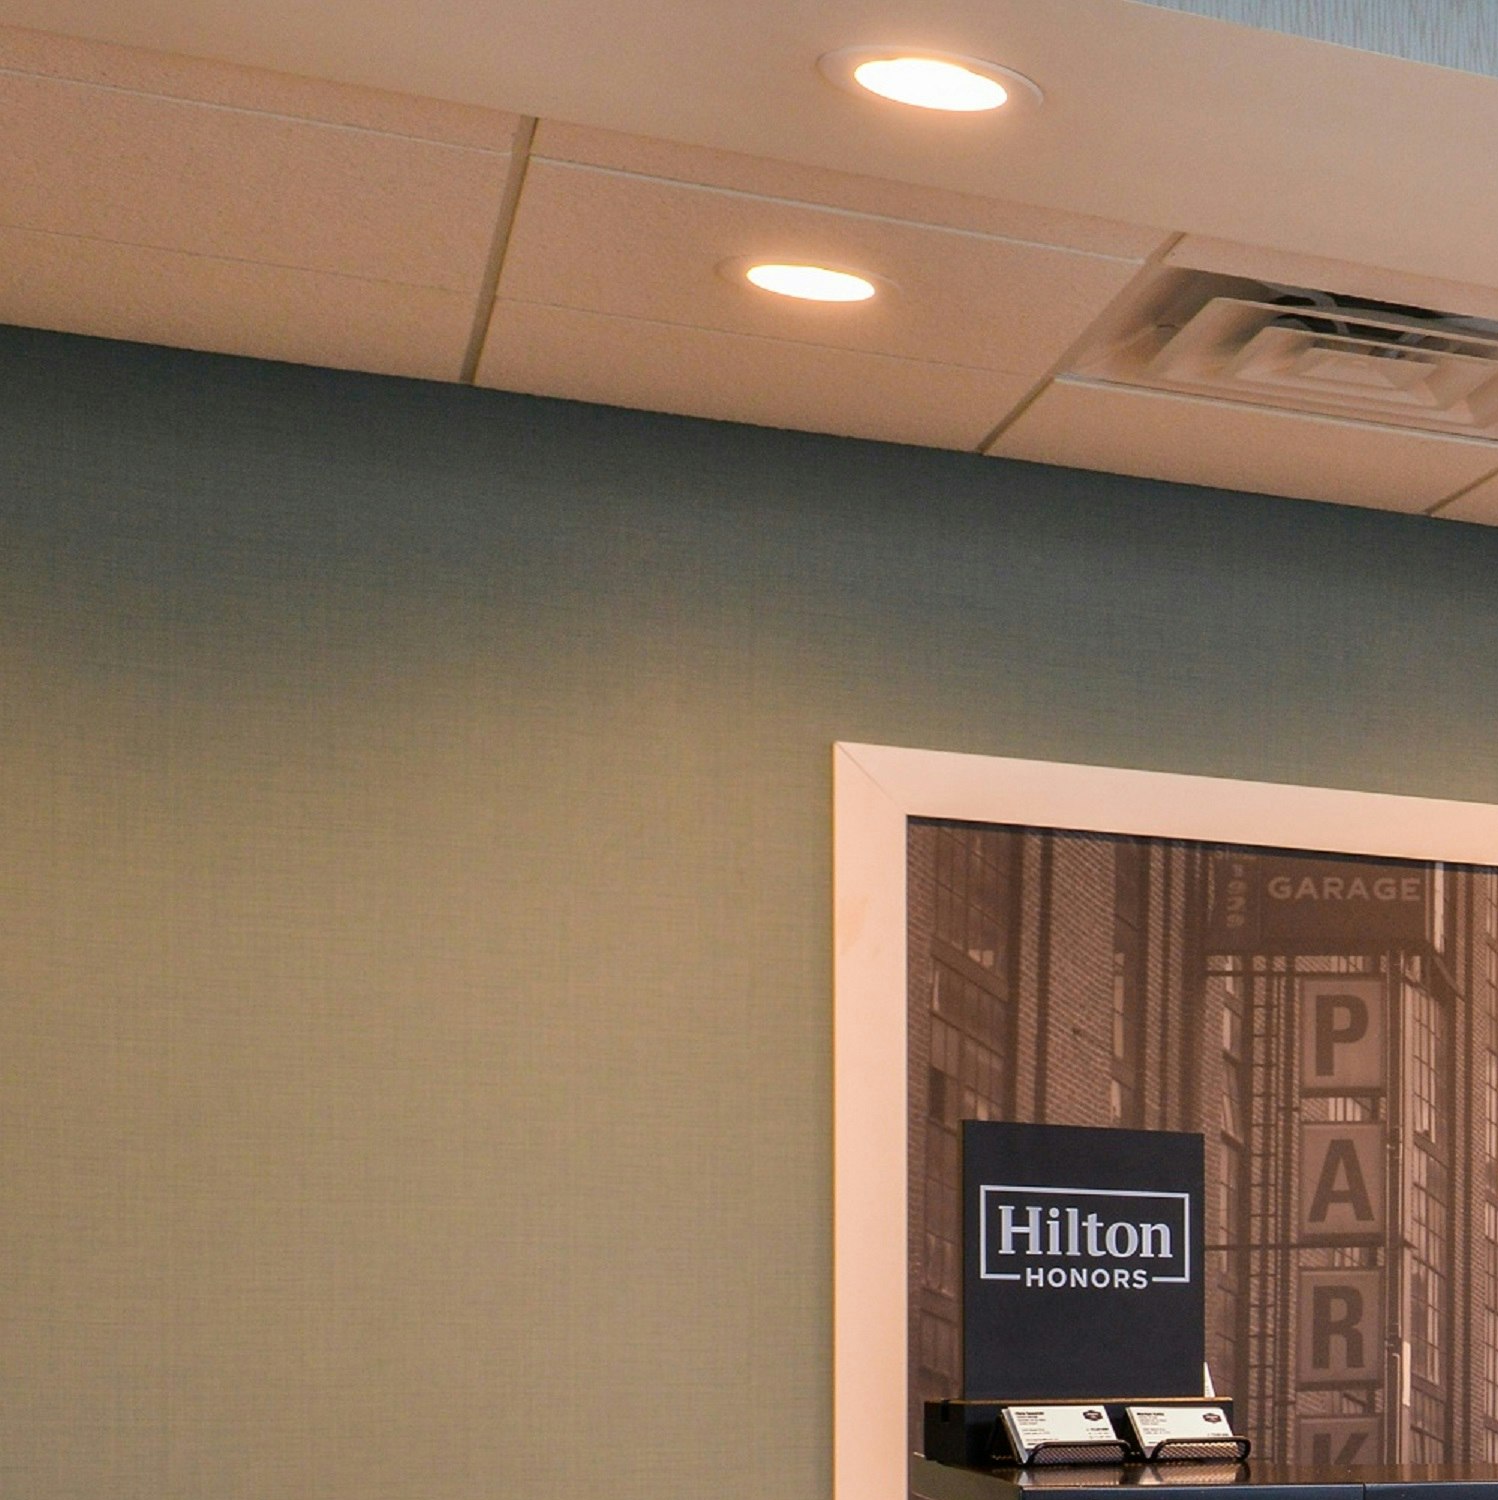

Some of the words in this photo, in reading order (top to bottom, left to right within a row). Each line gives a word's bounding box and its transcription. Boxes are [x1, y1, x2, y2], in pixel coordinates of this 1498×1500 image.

[1267, 876, 1422, 900] GARAGE
[998, 1205, 1174, 1258] Hilton
[1025, 1267, 1149, 1290] HONORS
